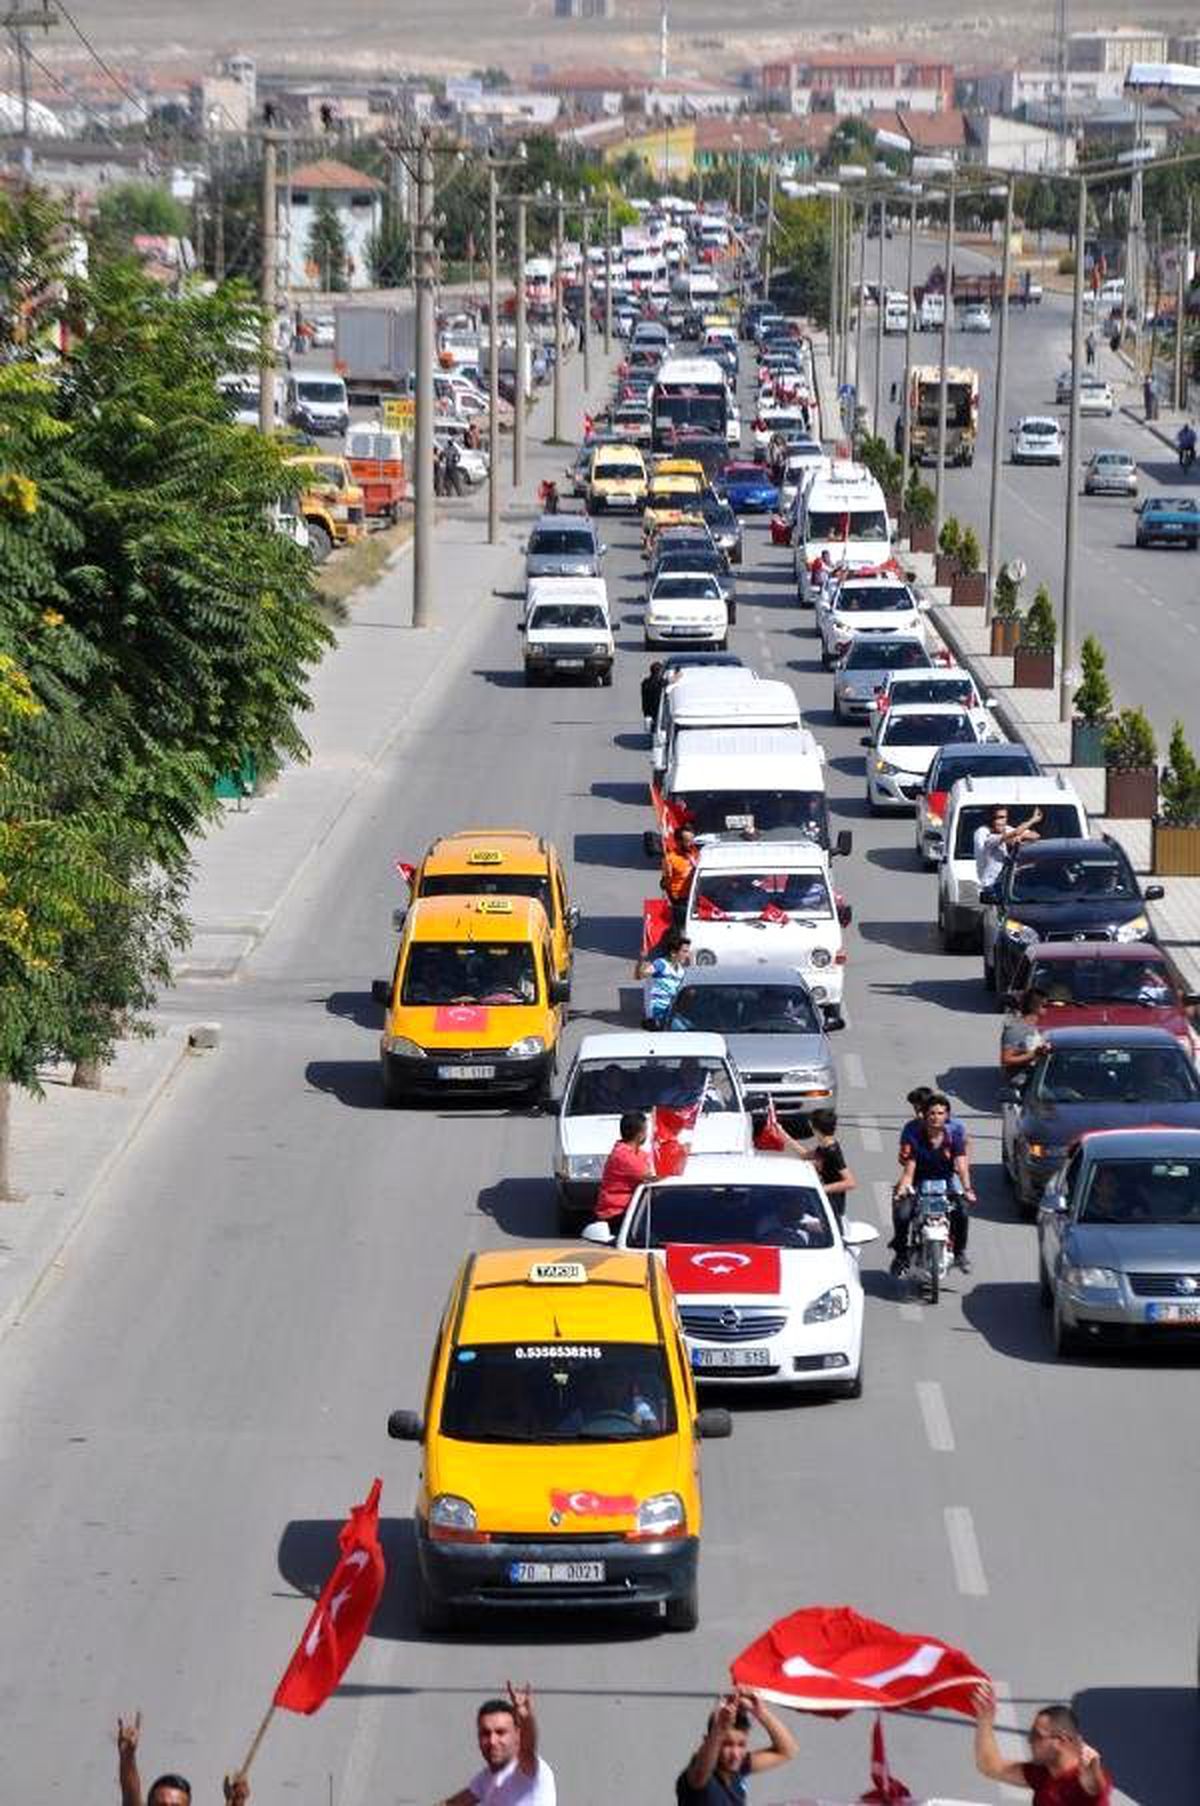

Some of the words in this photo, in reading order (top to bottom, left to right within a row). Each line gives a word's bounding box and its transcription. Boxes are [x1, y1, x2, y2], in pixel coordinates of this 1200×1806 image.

[519, 1564, 535, 1580] 70
[547, 1564, 555, 1580] T
[566, 1564, 600, 1580] 0021
